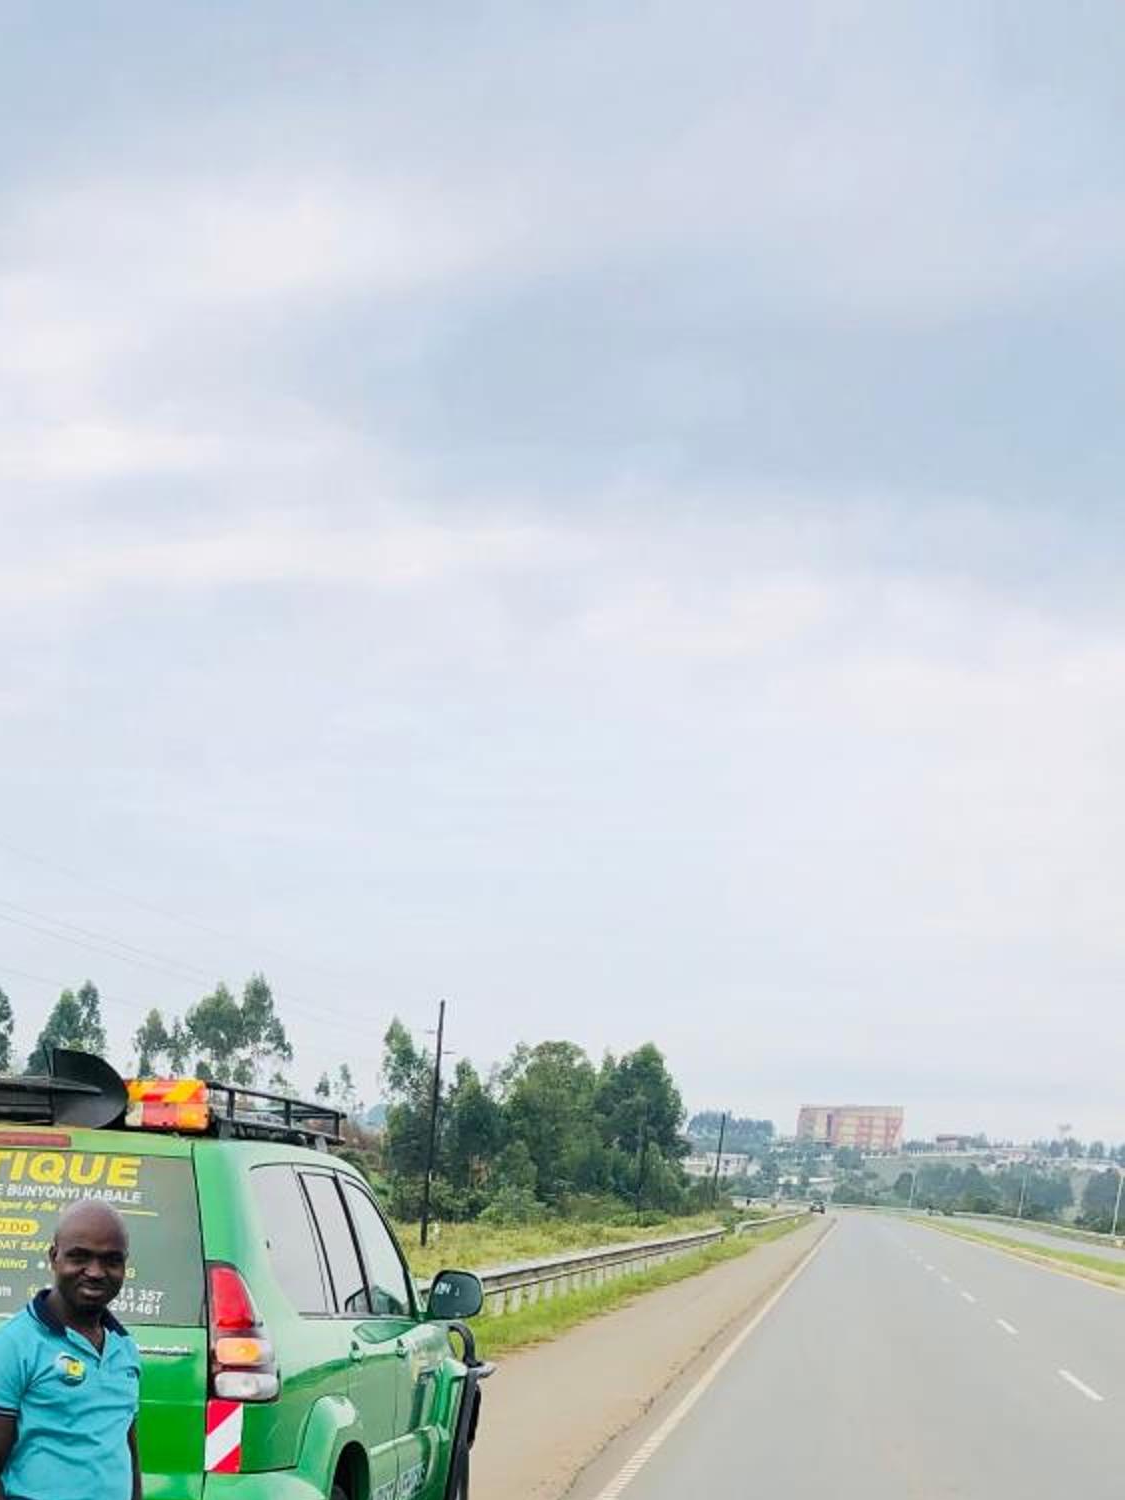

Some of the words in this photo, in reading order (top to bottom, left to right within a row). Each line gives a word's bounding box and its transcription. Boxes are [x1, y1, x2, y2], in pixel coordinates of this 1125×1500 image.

[6, 1184, 80, 1200] BUNYONYI
[83, 1188, 142, 1204] KABALE
[118, 1287, 134, 1299] 13
[138, 1288, 164, 1303] 357
